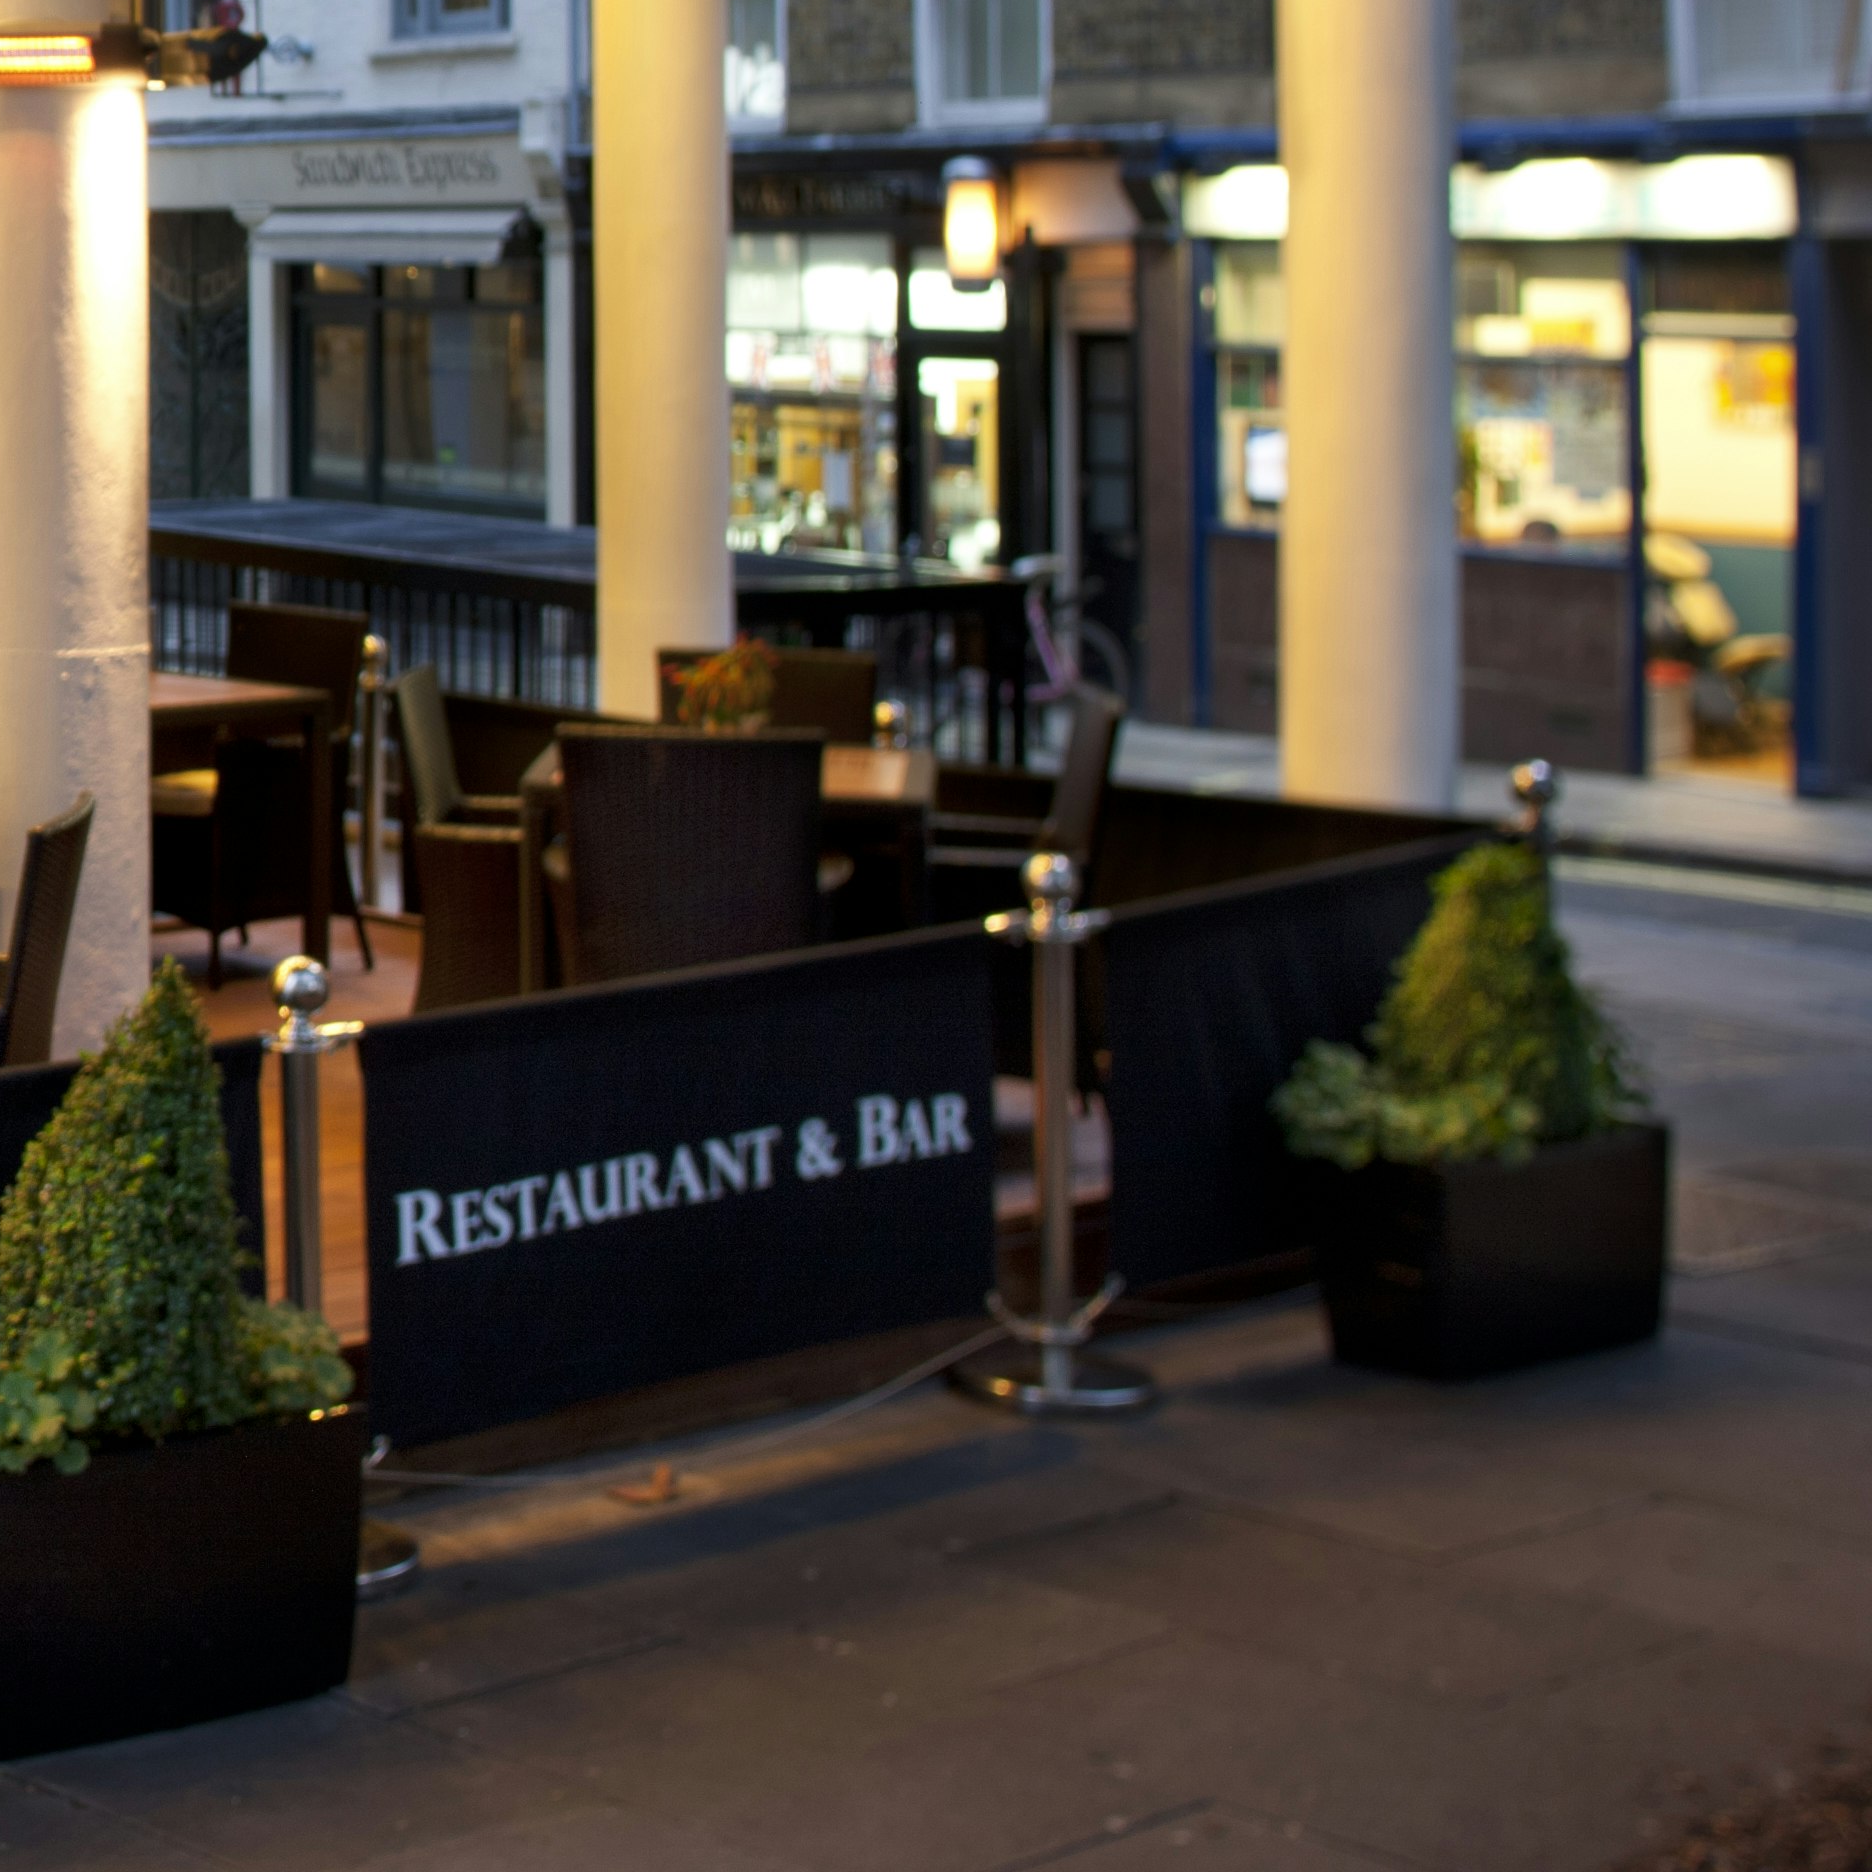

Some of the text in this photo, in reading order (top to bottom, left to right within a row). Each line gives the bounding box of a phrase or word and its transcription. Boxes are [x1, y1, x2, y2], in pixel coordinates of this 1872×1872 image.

[394, 1092, 972, 1267] RESTAURANT & BAR
